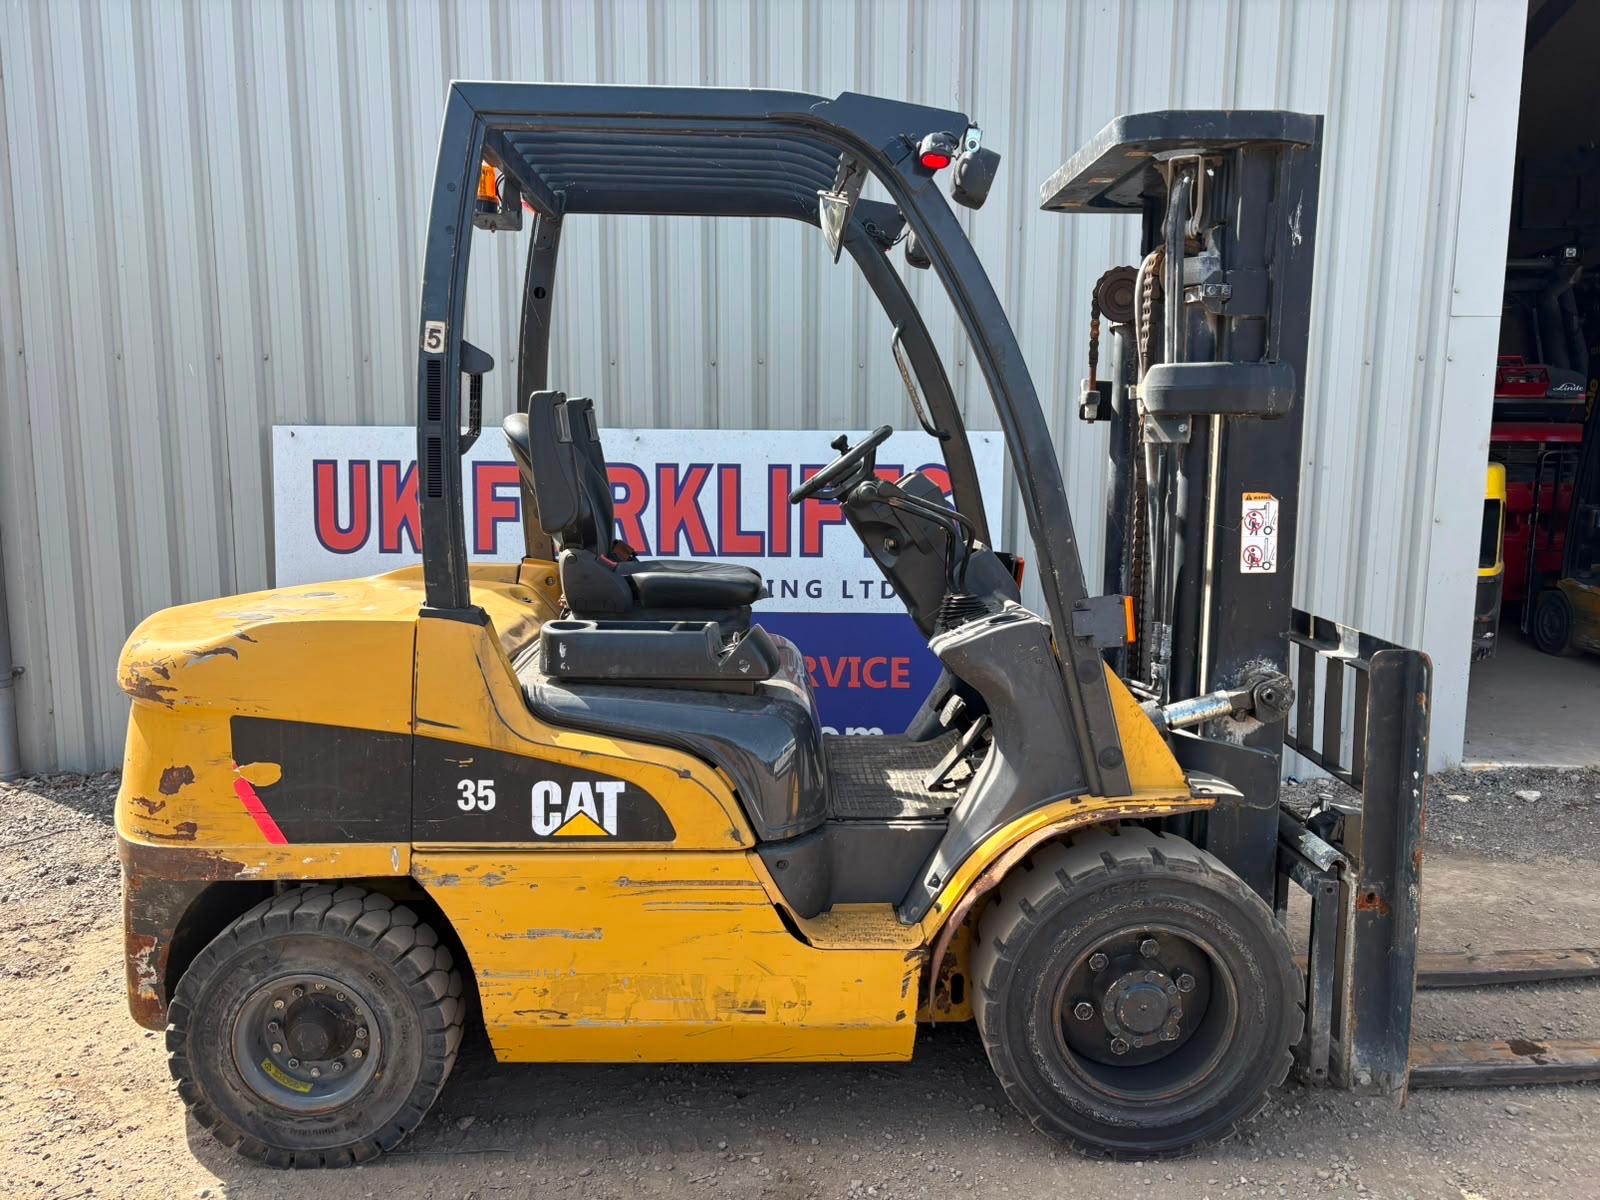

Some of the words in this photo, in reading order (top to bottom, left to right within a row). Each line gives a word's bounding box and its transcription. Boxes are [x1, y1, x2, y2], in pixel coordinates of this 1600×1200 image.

[426, 328, 442, 350] 5
[1552, 382, 1584, 392] Linde
[312, 459, 423, 555] UK
[842, 580, 898, 599] LTD
[456, 779, 497, 812] 35
[531, 780, 626, 837] CAT
